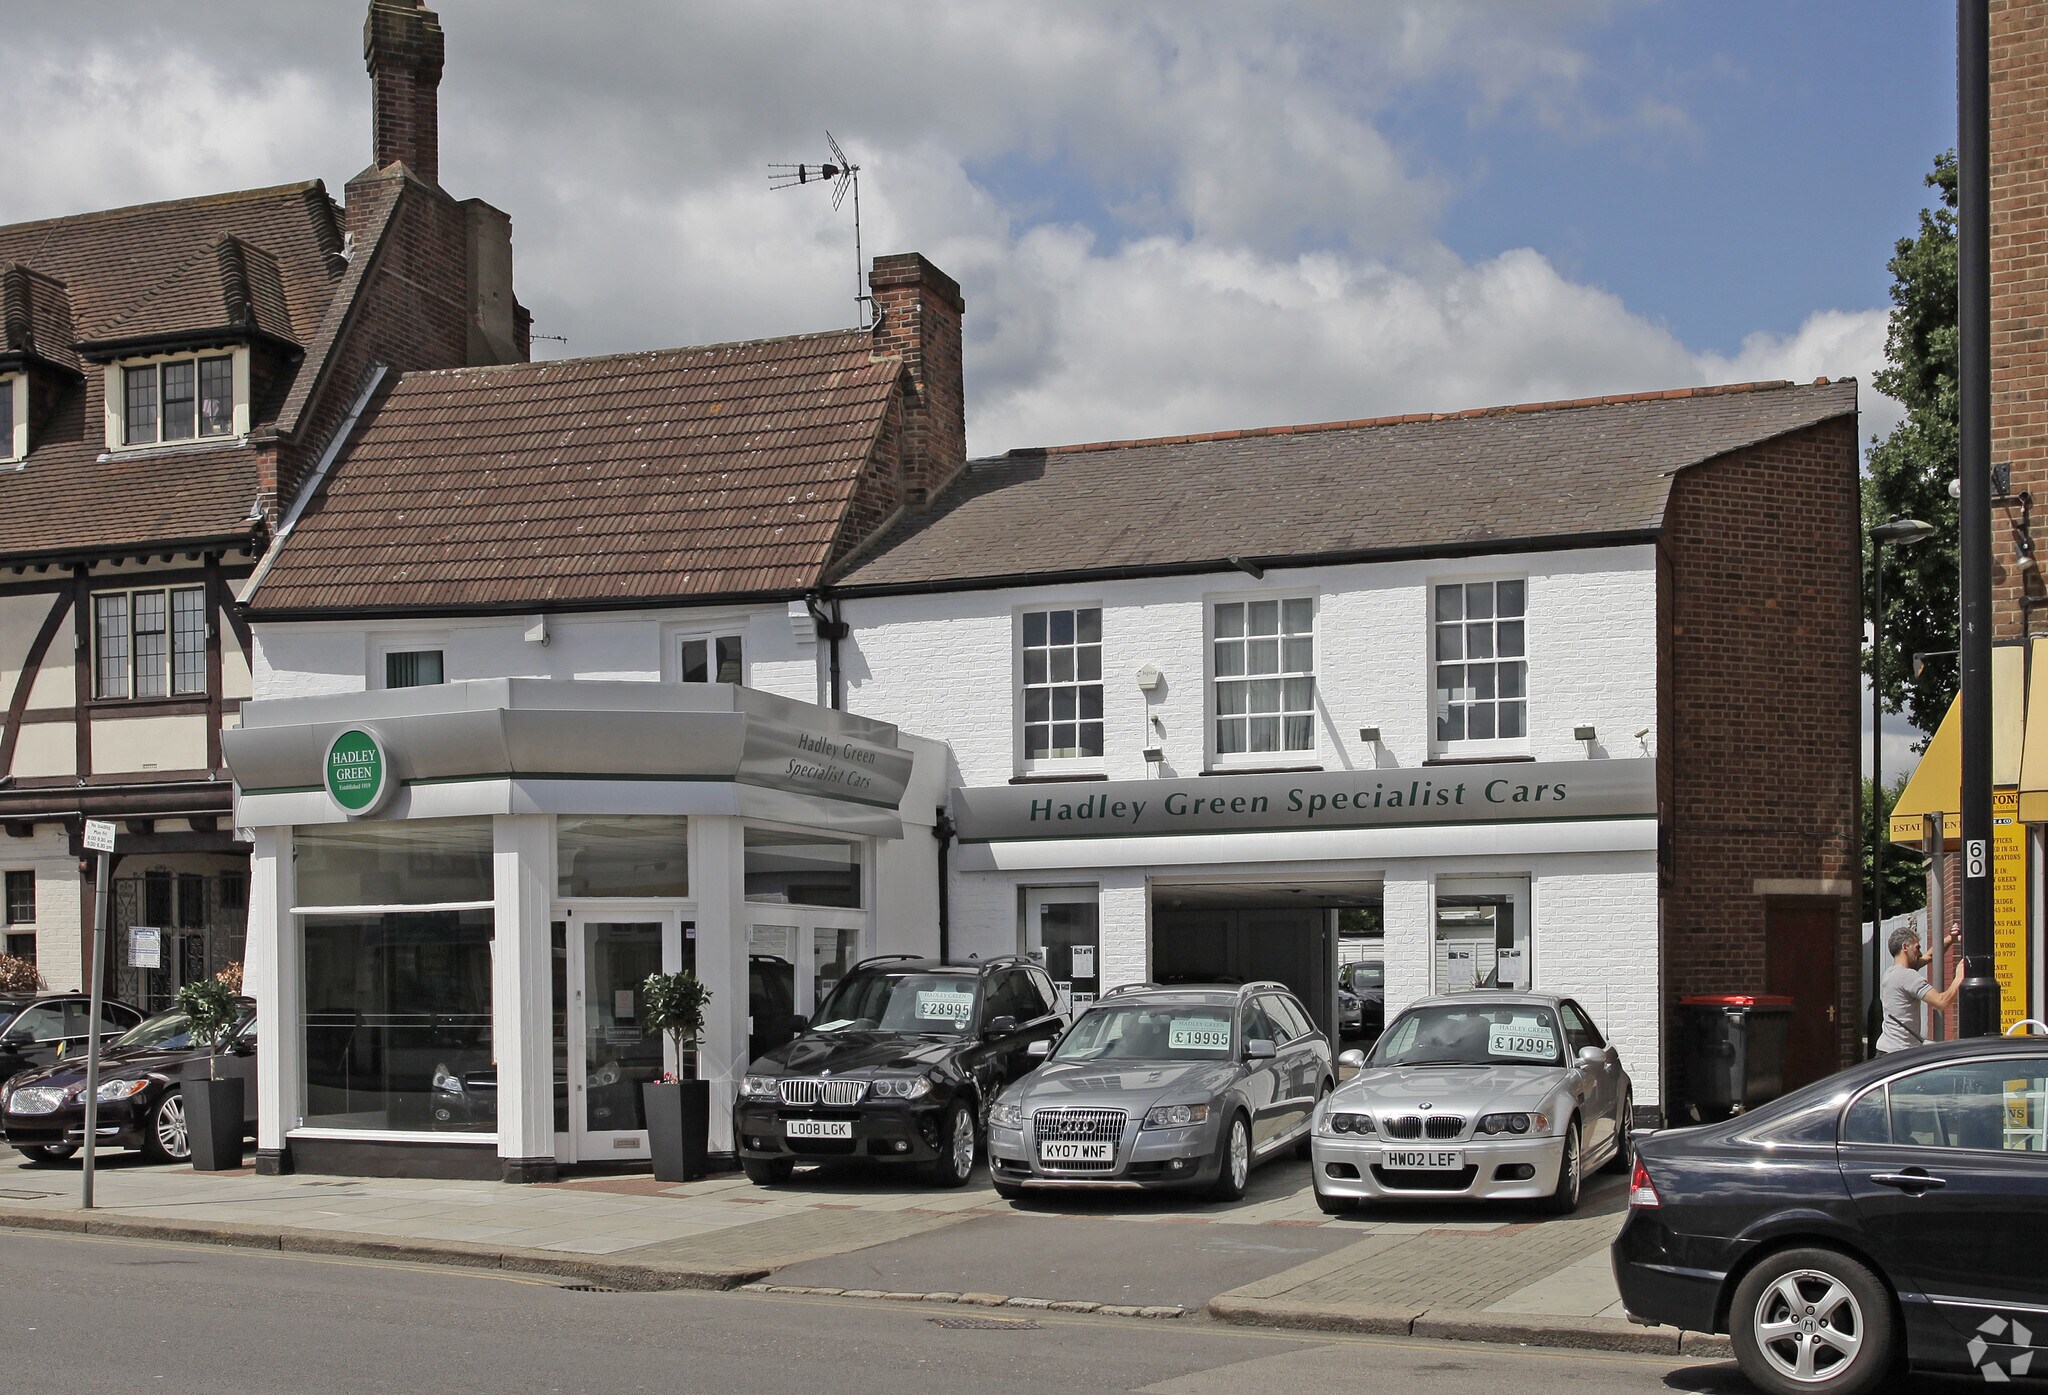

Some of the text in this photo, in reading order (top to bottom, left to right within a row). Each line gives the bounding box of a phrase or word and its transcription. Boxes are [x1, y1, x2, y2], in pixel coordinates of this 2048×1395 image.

[798, 733, 875, 764] Hadley Green
[332, 750, 376, 764] HADLEY
[336, 766, 372, 780] GREEN
[786, 758, 872, 788] Specialist Cars
[1030, 779, 1566, 824] Hadley Green Specialist Cars
[1993, 794, 2018, 804] TON
[1894, 823, 1922, 832] ESTAT
[922, 1002, 970, 1016] £28995
[1175, 1032, 1228, 1045] £19995
[1494, 1036, 1554, 1053] £12995
[791, 1122, 846, 1135] LO08 LGK
[1046, 1145, 1107, 1158] KY07 WNF
[1389, 1152, 1456, 1166] HW02 LEF
